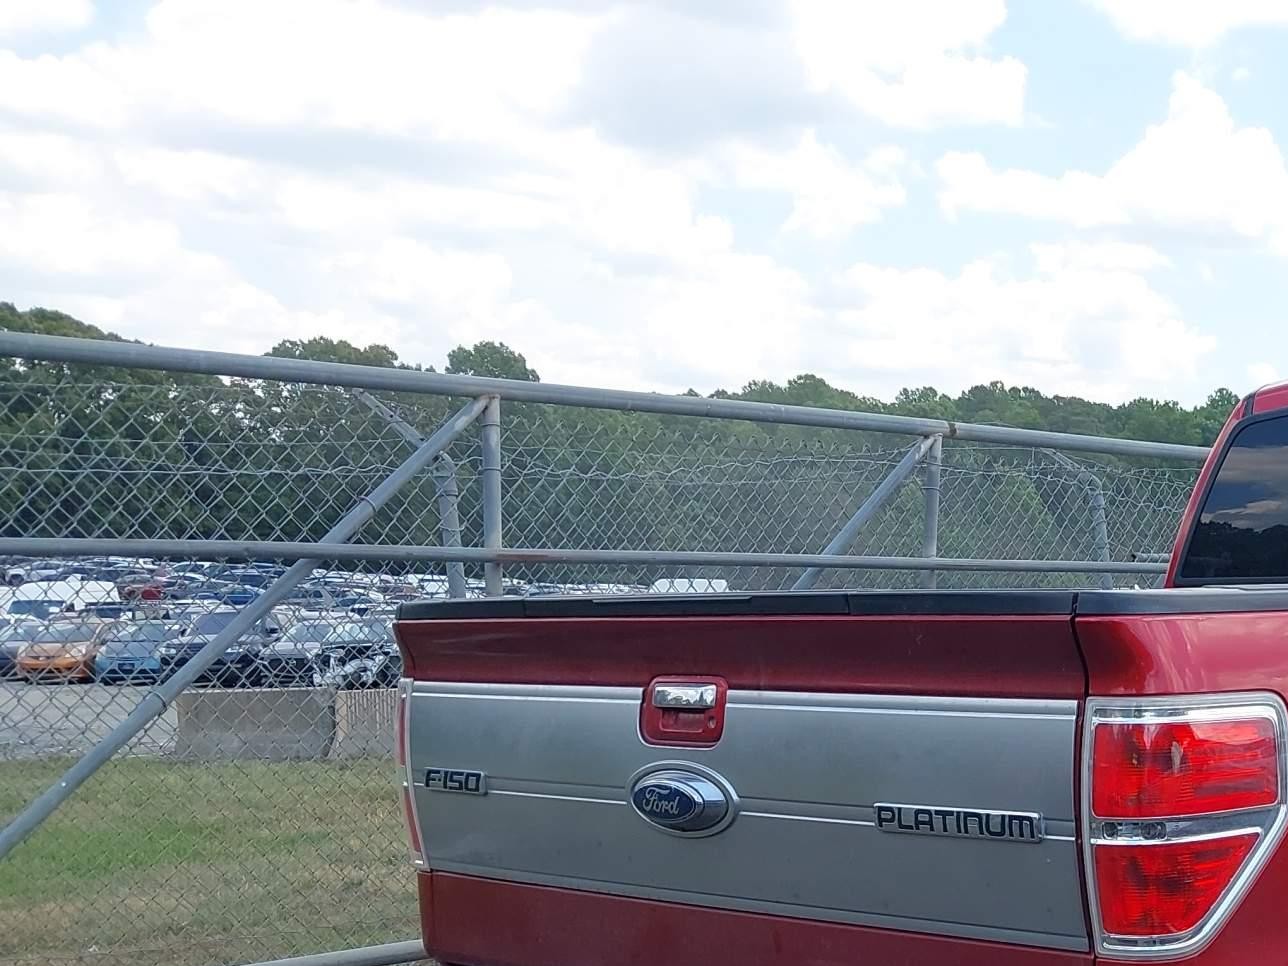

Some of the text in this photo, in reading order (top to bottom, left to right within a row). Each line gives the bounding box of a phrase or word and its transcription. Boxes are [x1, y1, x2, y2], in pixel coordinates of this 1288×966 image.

[425, 768, 482, 793] F-150
[642, 786, 681, 815] Ford
[876, 805, 1036, 839] PLATINUM
